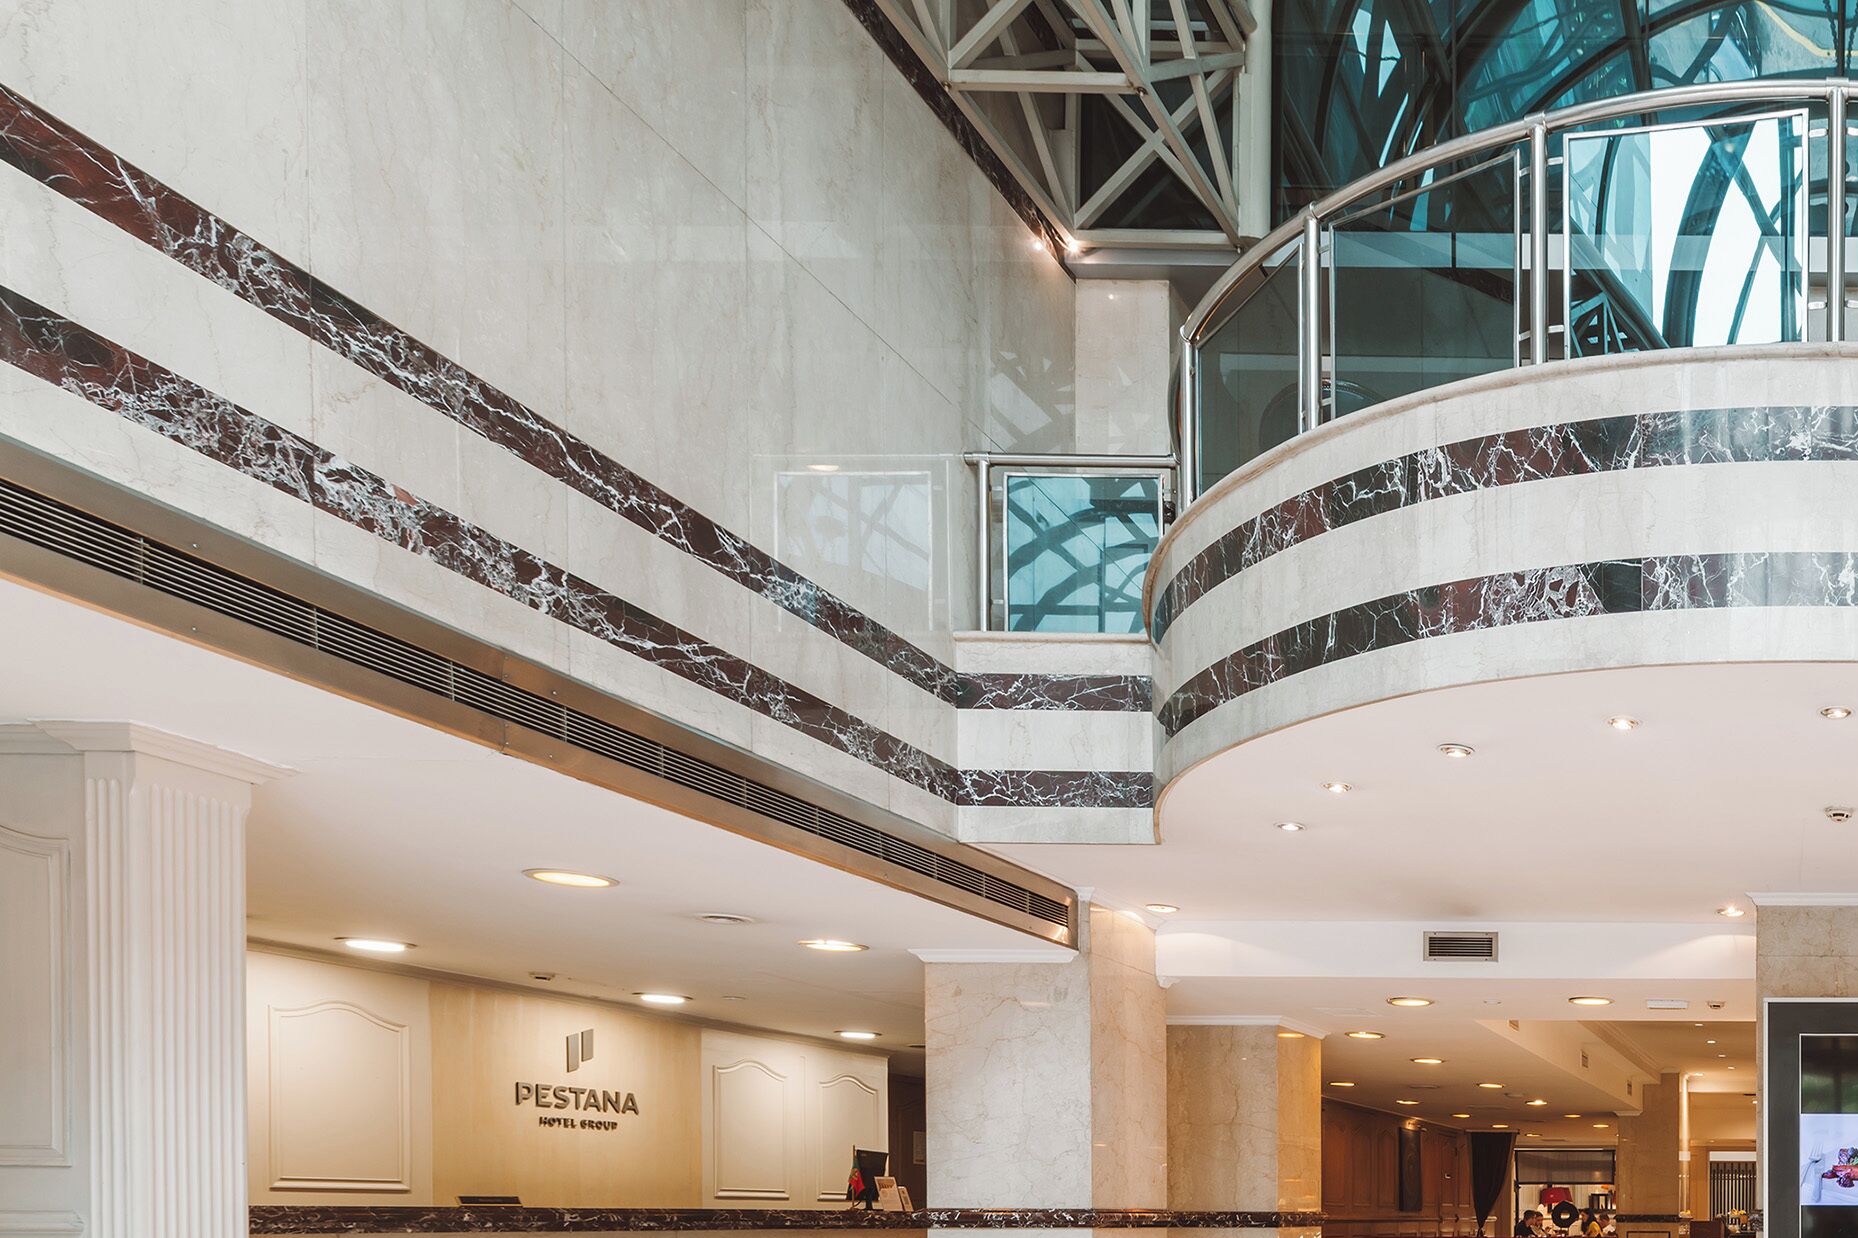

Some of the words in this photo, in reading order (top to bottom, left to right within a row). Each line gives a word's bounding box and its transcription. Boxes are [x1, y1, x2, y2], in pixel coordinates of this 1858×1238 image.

[515, 1082, 639, 1115] PESTANA
[539, 1116, 577, 1129] HOTEL
[580, 1119, 618, 1131] GROUP
